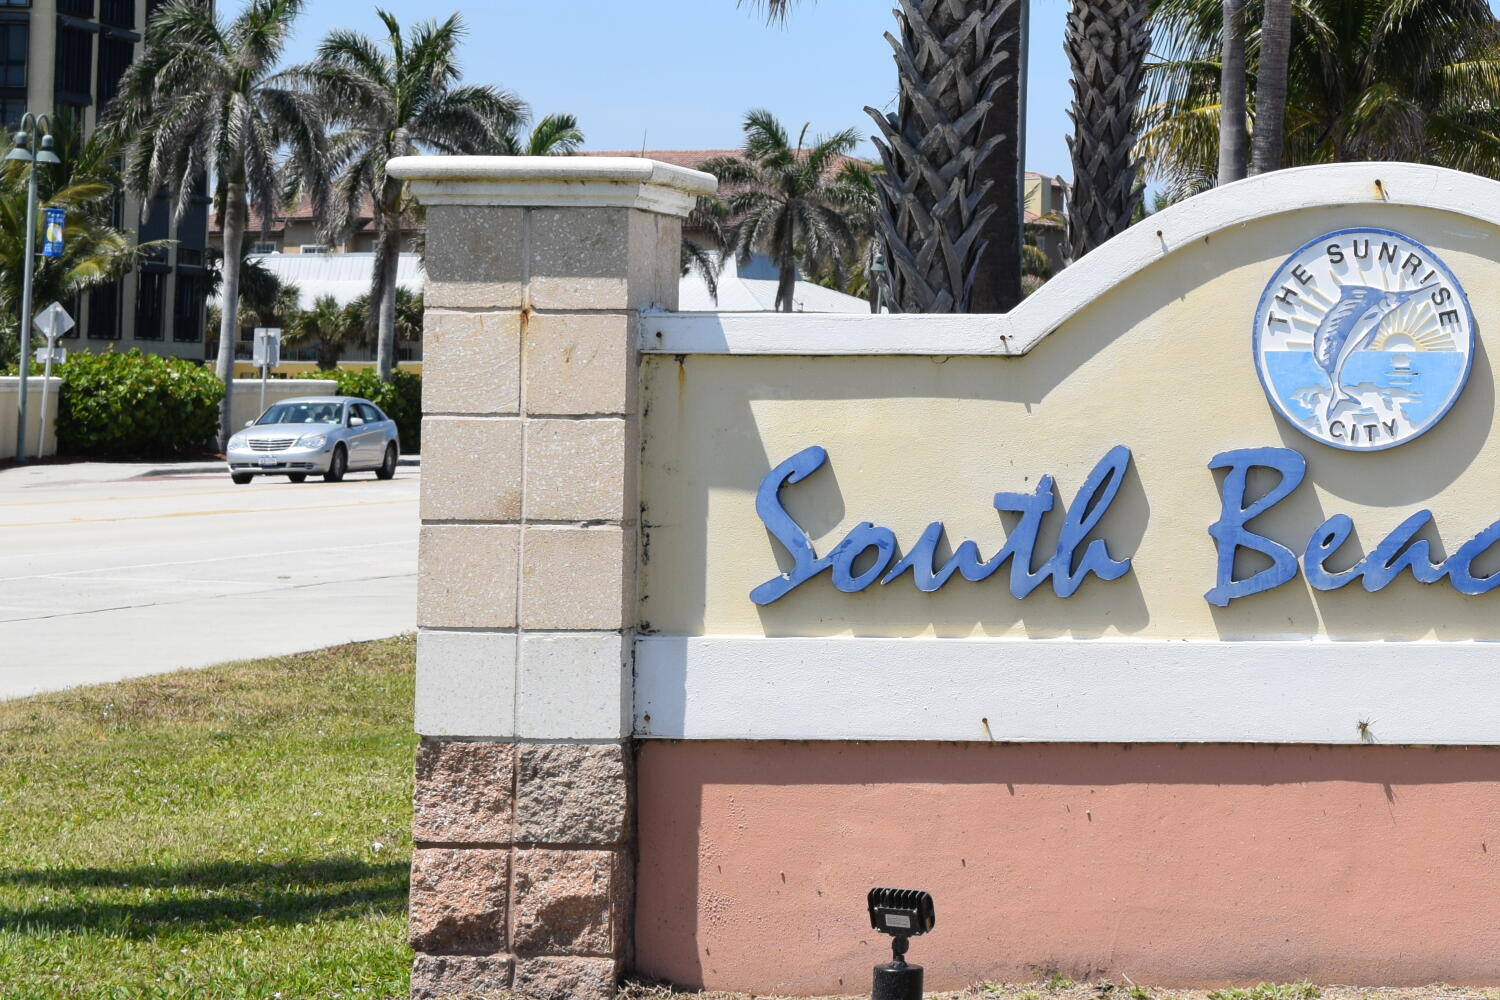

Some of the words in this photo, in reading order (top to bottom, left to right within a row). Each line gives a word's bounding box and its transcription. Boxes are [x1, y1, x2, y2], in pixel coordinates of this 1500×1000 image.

[1267, 263, 1314, 327] THE
[1326, 239, 1460, 327] SUNRISE
[1328, 418, 1397, 442] CITY
[749, 445, 1132, 605] South
